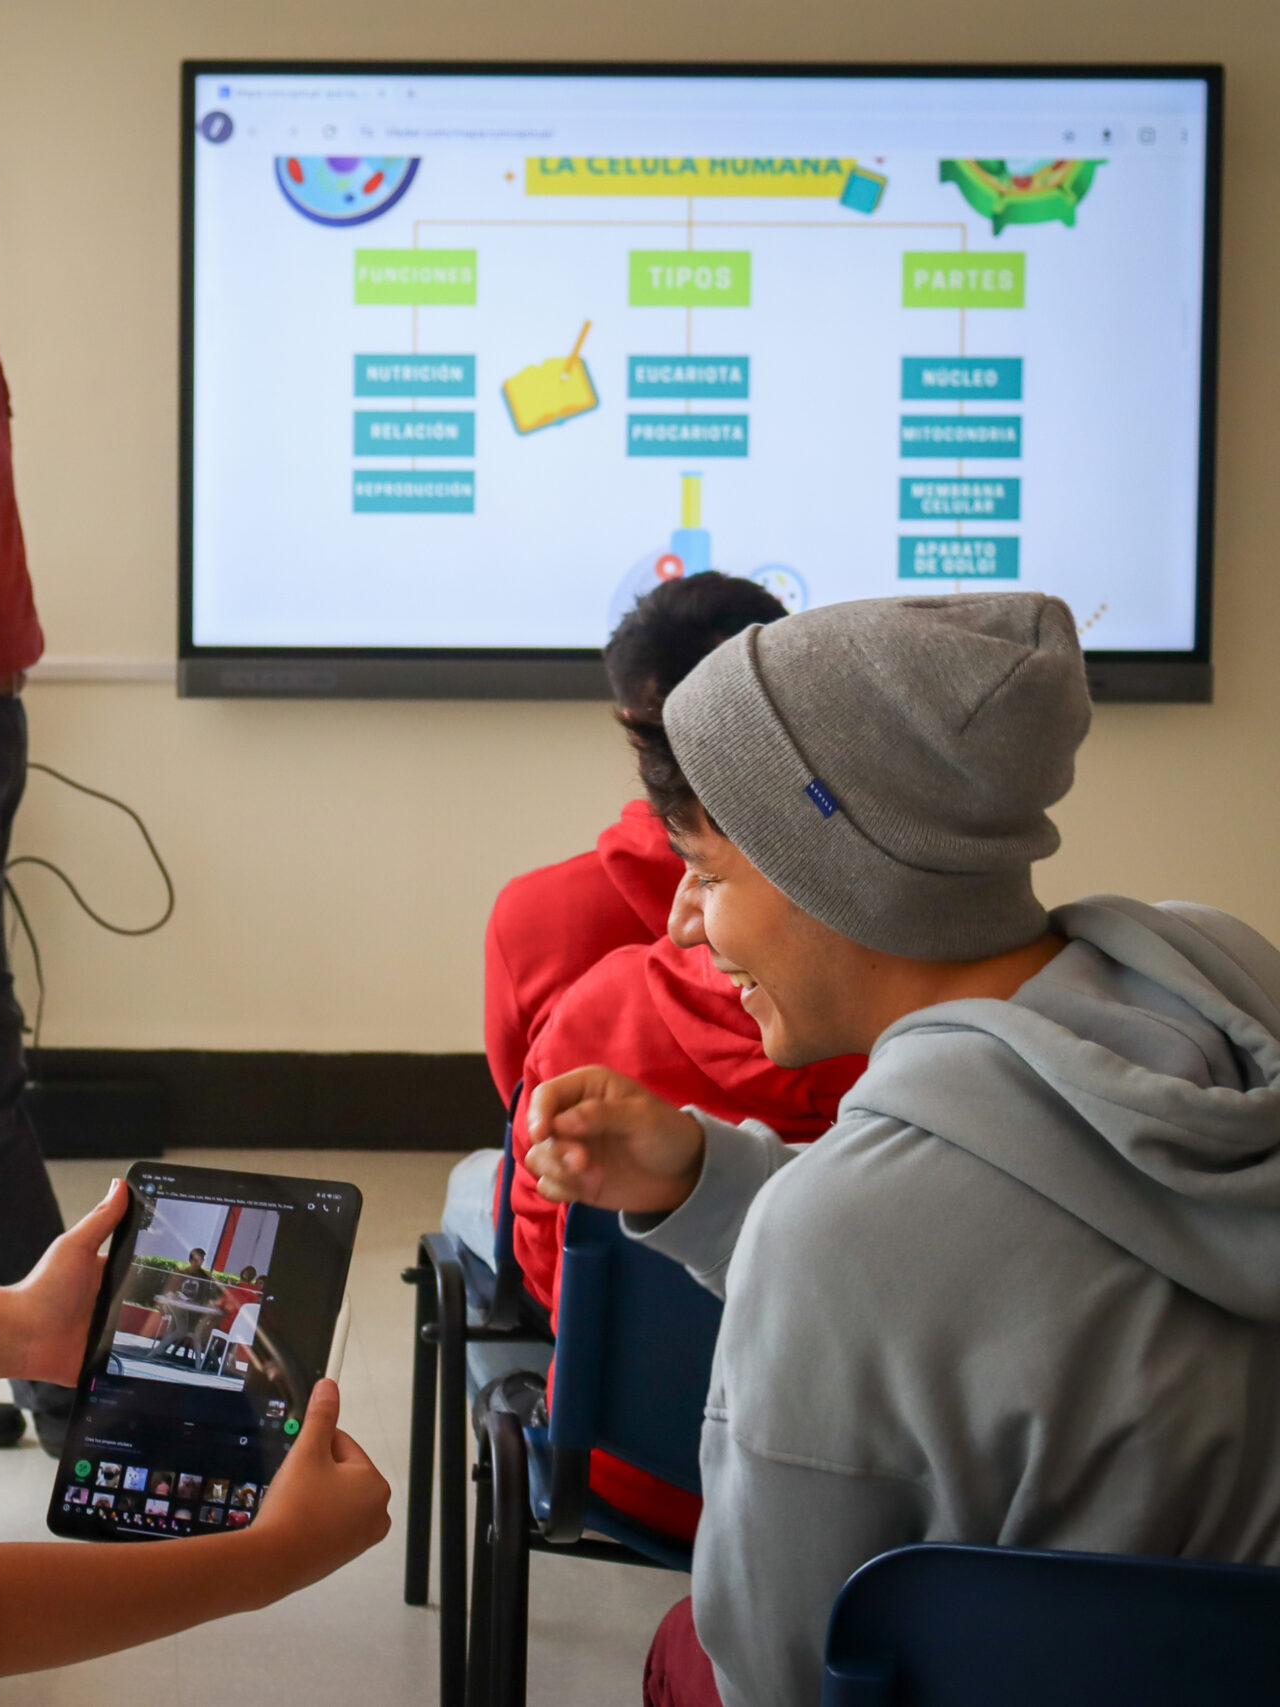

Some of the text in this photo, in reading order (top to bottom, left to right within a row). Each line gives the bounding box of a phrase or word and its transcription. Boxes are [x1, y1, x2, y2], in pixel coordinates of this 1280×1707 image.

[538, 156, 577, 176] LA
[709, 156, 843, 176] HUMANA
[358, 266, 474, 285] FUNCIONES
[648, 265, 733, 290] TIPOS
[913, 268, 1014, 291] PARTES
[366, 363, 464, 383] NUTRICIÓN
[635, 365, 742, 384] EUCARIOTA
[921, 367, 999, 388] NÚCLEO
[369, 420, 459, 441] RELACIÓN
[632, 424, 744, 442] PROCARIOTA
[903, 425, 1017, 442] MITOCONDRIA
[355, 480, 472, 498] REPRODUCCIÓN
[911, 483, 1005, 498] MEMBRANA
[921, 498, 994, 514] CELULAR
[914, 541, 996, 557] APARATO
[914, 558, 937, 574] DE
